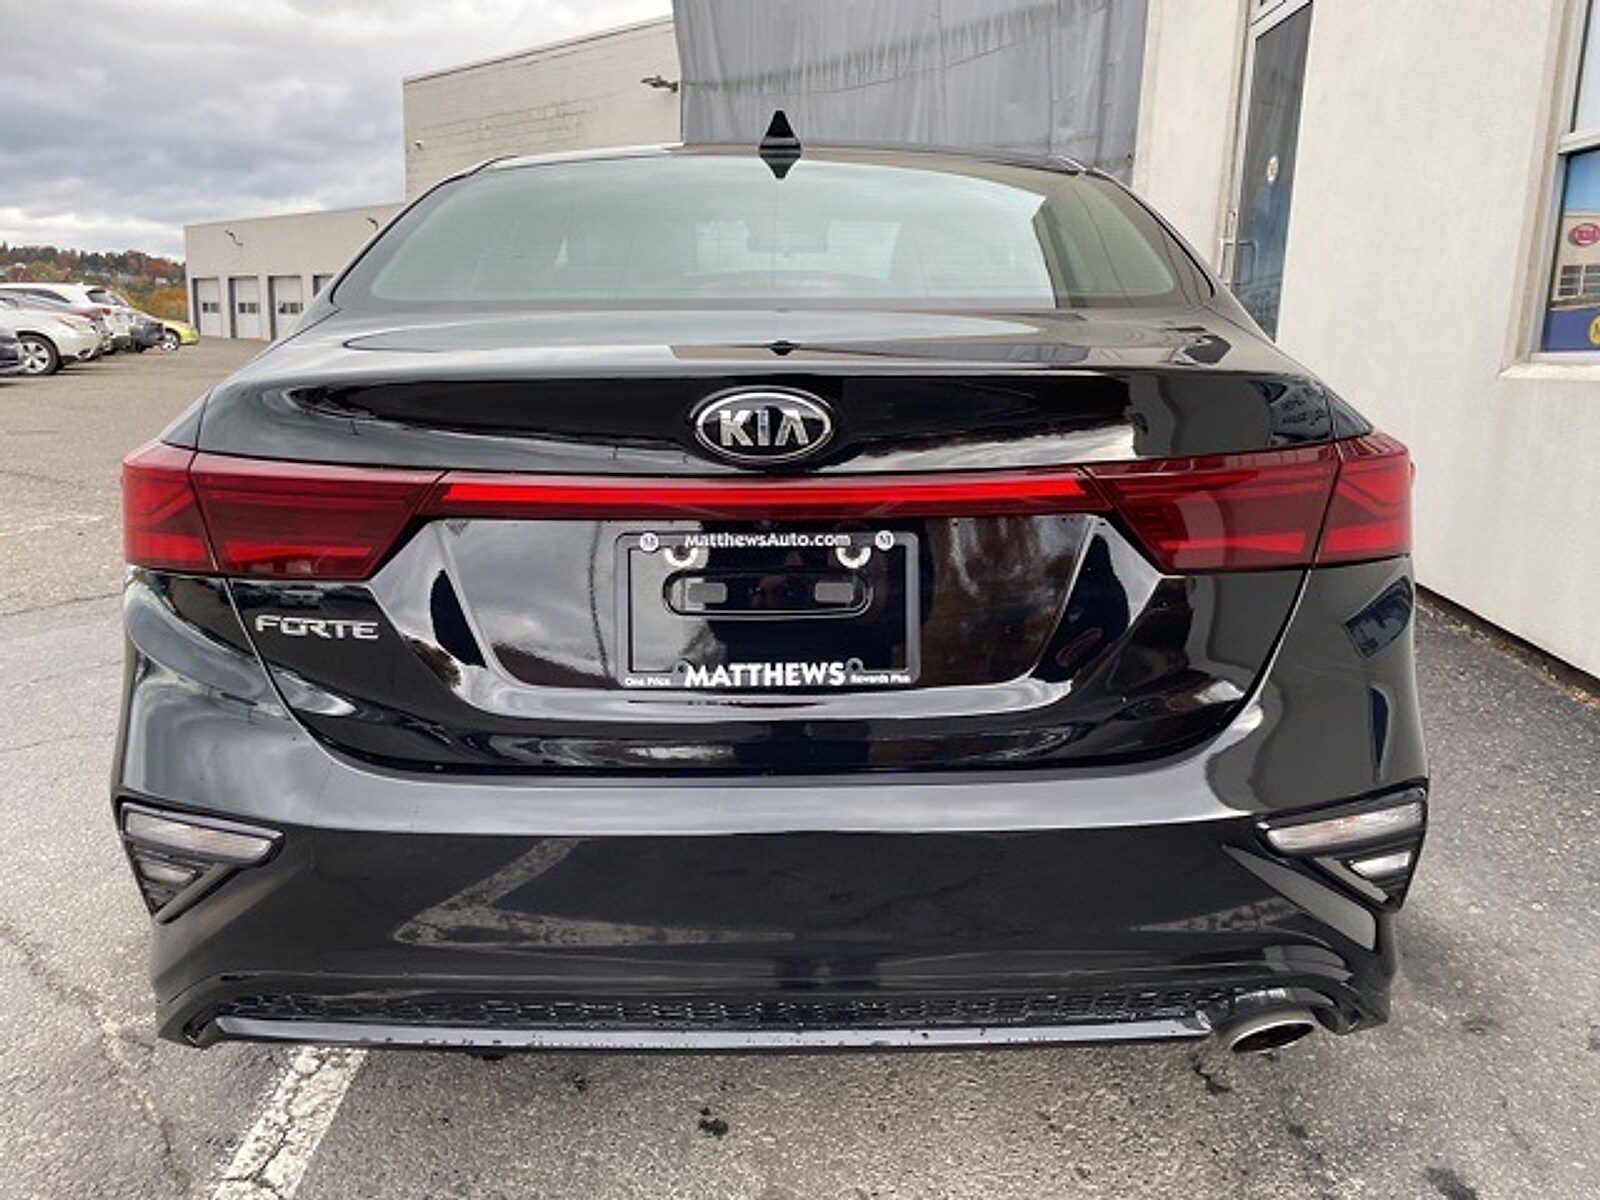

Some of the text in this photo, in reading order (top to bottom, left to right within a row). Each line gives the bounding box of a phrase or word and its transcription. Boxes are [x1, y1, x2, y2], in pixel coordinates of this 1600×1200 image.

[719, 409, 810, 447] KIA
[684, 532, 851, 548] MatthewsAuto.com
[255, 614, 379, 639] FORTE
[684, 662, 845, 687] MATTHEWS
